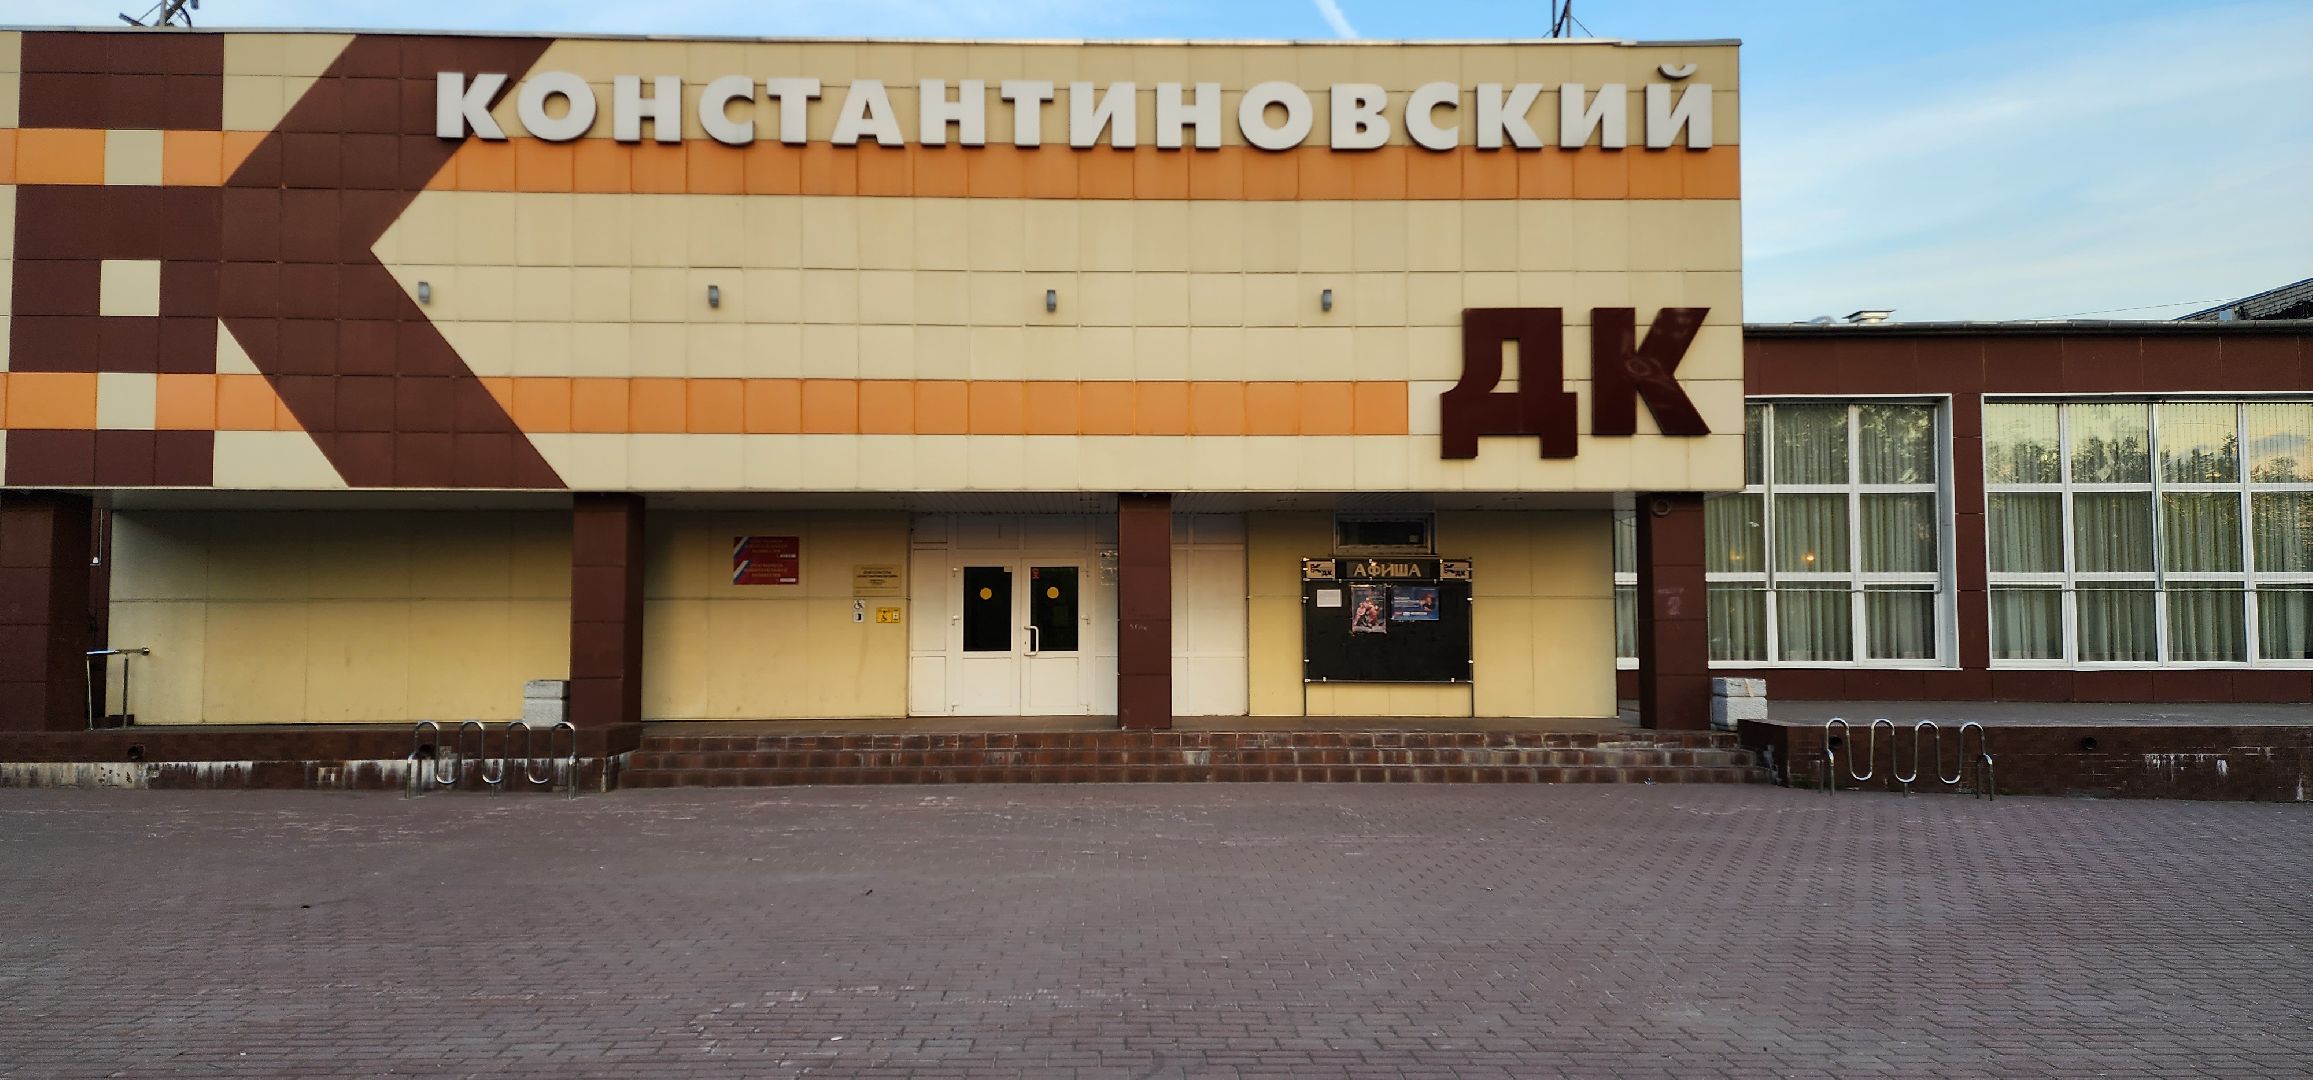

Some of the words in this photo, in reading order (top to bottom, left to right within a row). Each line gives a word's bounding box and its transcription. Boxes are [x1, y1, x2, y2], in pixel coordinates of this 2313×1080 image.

[436, 63, 1713, 151] КОНСТАНТИНОВСКИЙ
[1440, 307, 1711, 460] ДК
[1353, 562, 1422, 578] АФИША
